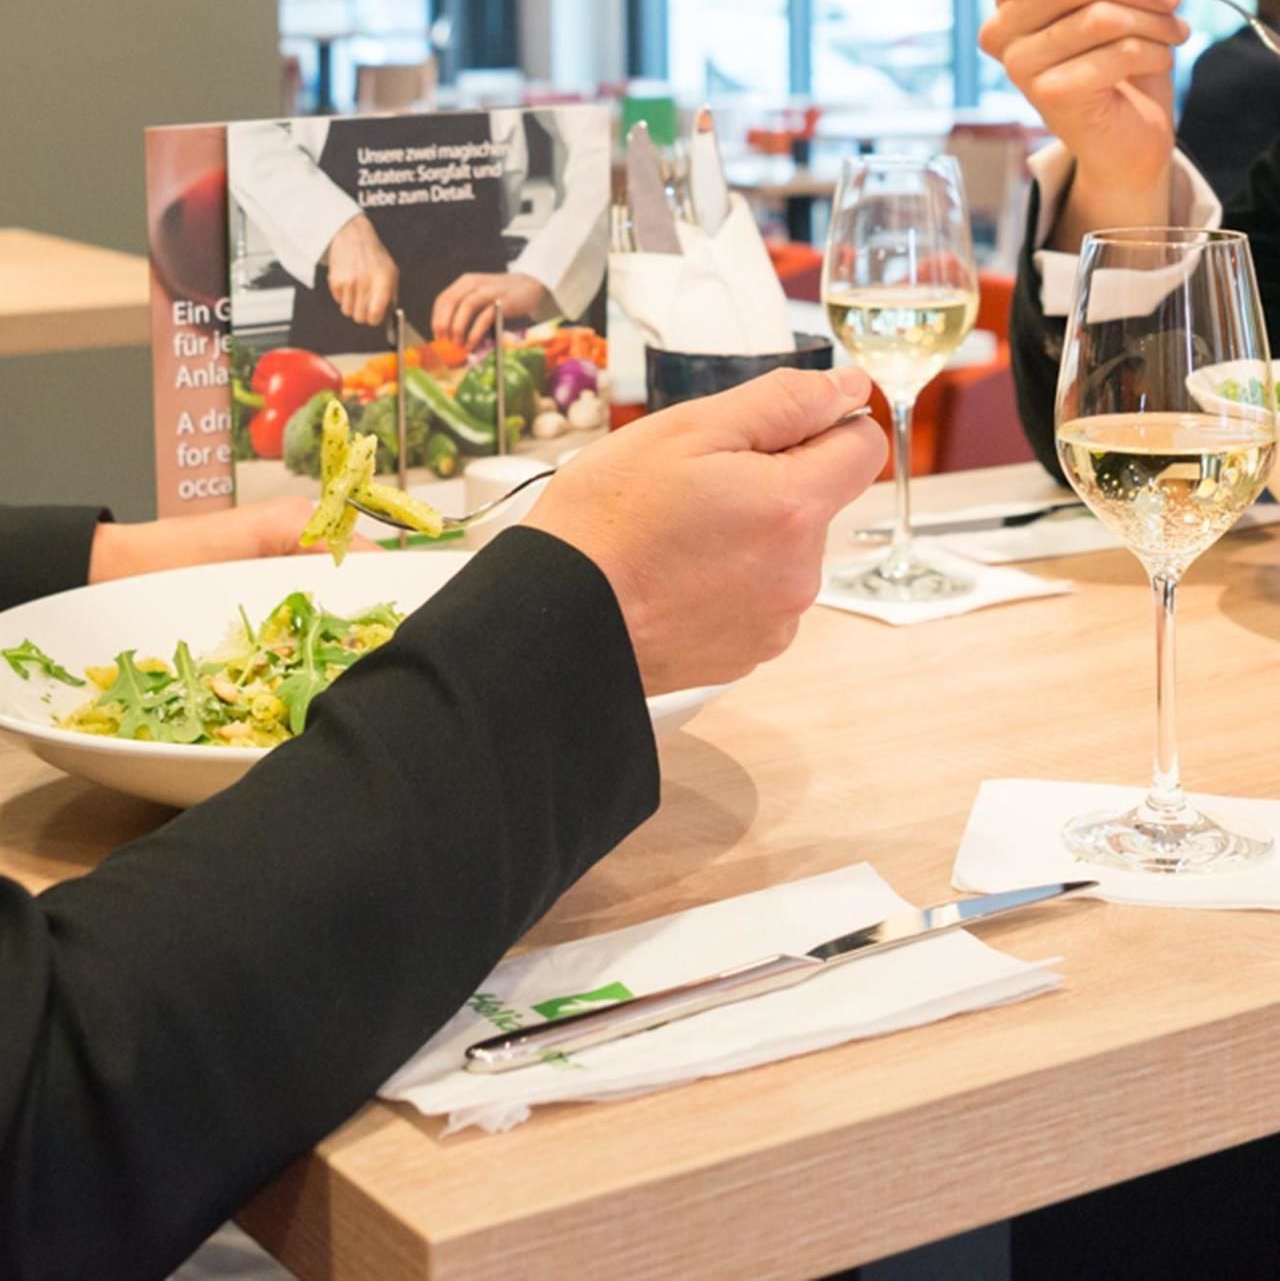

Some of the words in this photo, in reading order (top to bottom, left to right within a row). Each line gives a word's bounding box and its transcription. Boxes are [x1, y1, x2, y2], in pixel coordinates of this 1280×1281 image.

[357, 146, 404, 164] Unsere
[405, 143, 436, 161] zwei
[357, 168, 416, 186] Zutaten:
[417, 162, 471, 184] Sorgfalt
[473, 162, 503, 179] und
[357, 187, 397, 207] Liebe
[398, 190, 429, 204] zum
[430, 183, 475, 203] Detail.
[172, 299, 210, 326] Ein
[173, 330, 209, 357] für
[175, 361, 229, 389] Anla
[176, 410, 195, 436] A
[176, 440, 211, 468] for
